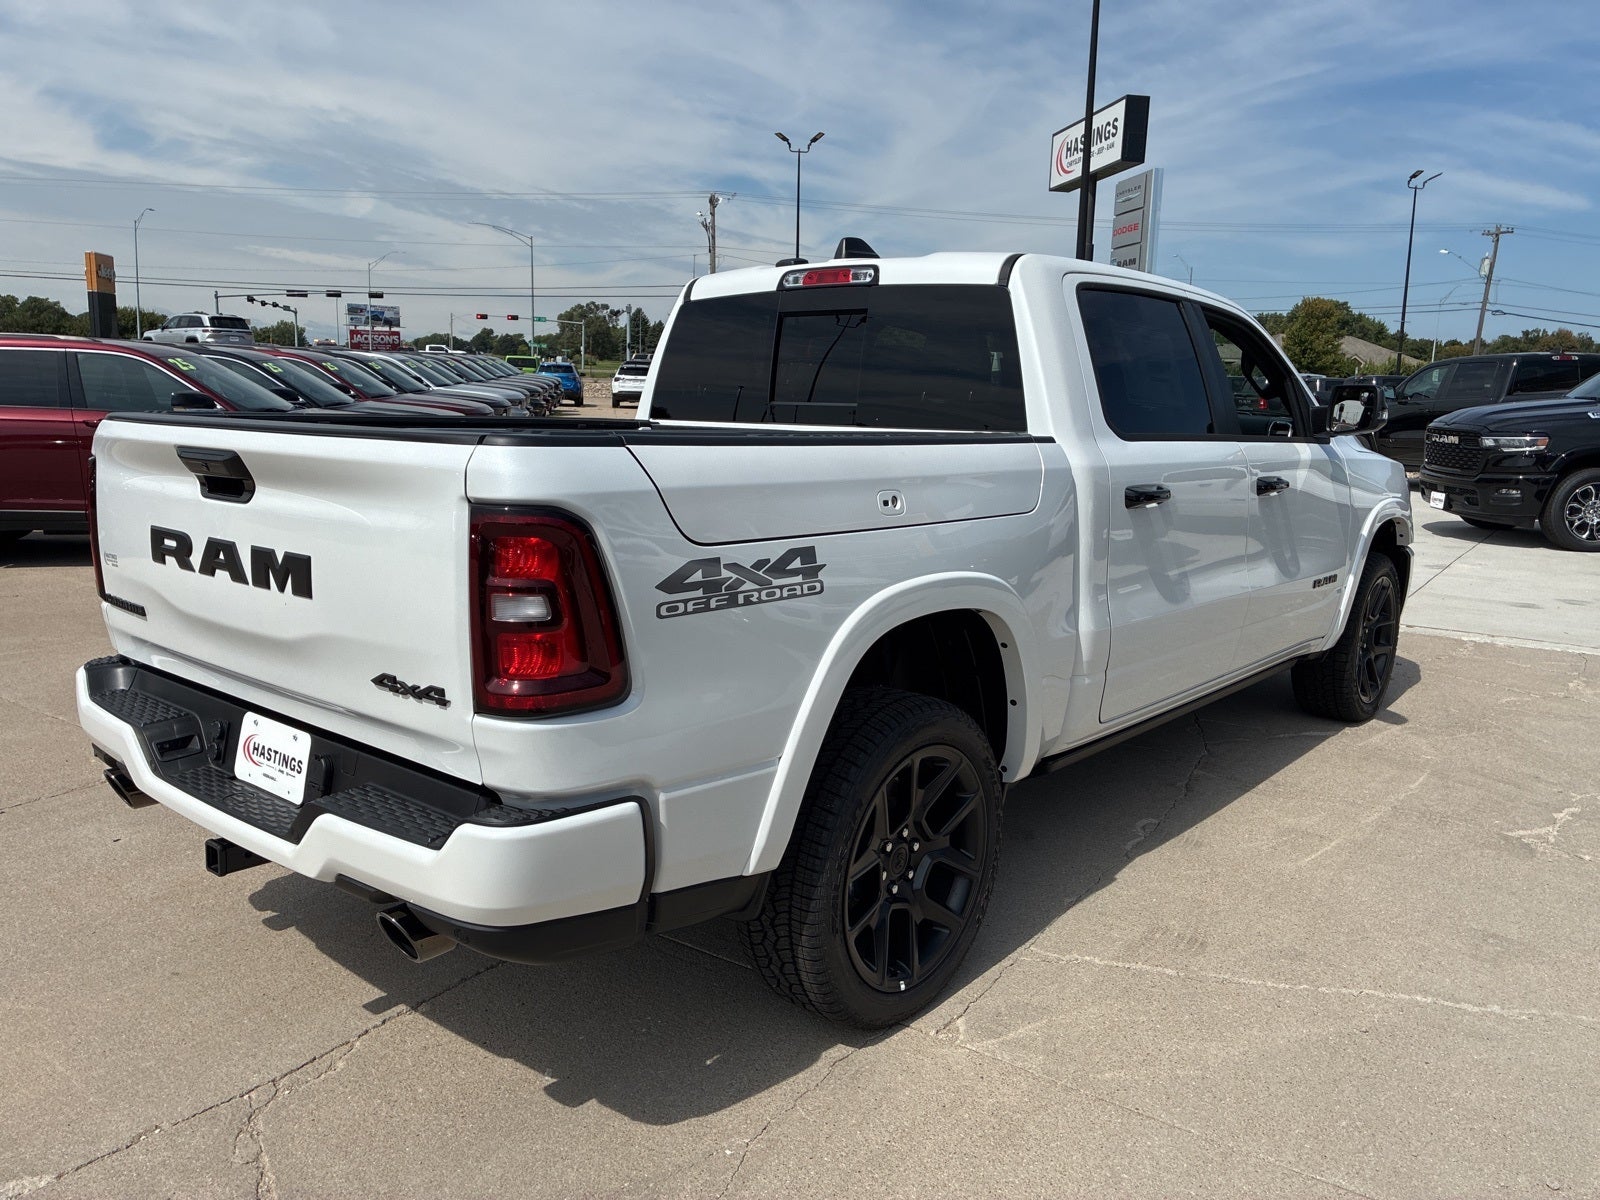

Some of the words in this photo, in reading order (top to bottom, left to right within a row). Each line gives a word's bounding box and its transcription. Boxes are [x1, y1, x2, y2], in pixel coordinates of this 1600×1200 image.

[1065, 117, 1119, 160] HASINGS
[1115, 185, 1142, 197] CHRYSLER
[1112, 222, 1140, 237] DODGE
[1116, 257, 1137, 267] RAM
[1431, 433, 1459, 445] RAM
[150, 525, 313, 600] RAM
[1312, 573, 1338, 590] RAM
[660, 595, 729, 616] OFF
[737, 581, 822, 605] ROAD
[252, 741, 303, 775] HASTINGS
